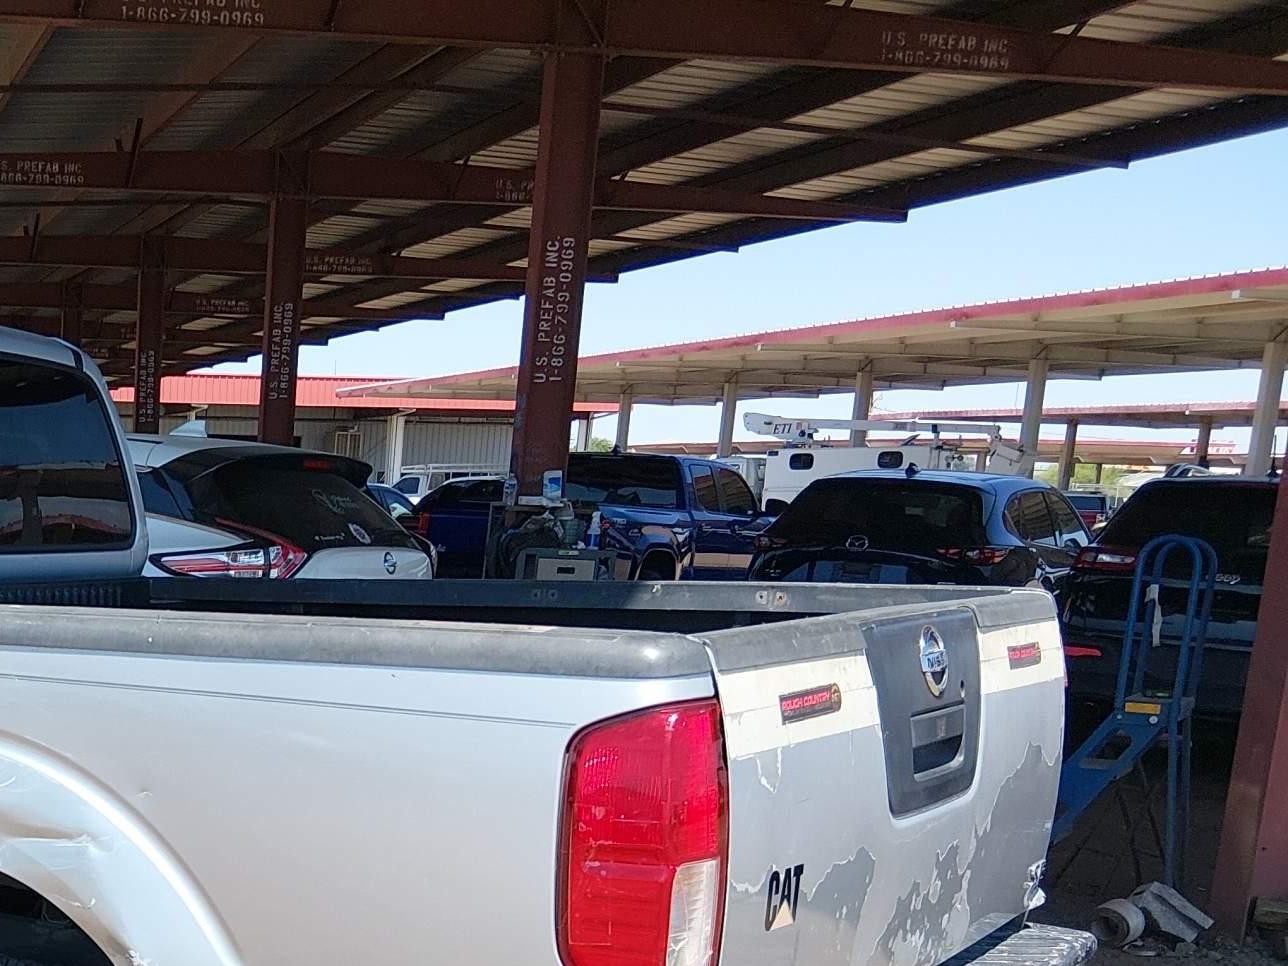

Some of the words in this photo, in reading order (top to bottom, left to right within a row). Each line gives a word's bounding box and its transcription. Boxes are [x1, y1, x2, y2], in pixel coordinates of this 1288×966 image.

[919, 33, 977, 51] PREFAB
[545, 236, 561, 268] INC.
[538, 277, 557, 342] PREFAB
[549, 237, 575, 382] 1-866-799-0969
[271, 329, 282, 372] PREFAB
[279, 303, 293, 399] 1-866-799-0969
[533, 351, 549, 383] U.S.
[773, 423, 792, 435] ETI
[765, 864, 805, 932] CAT
